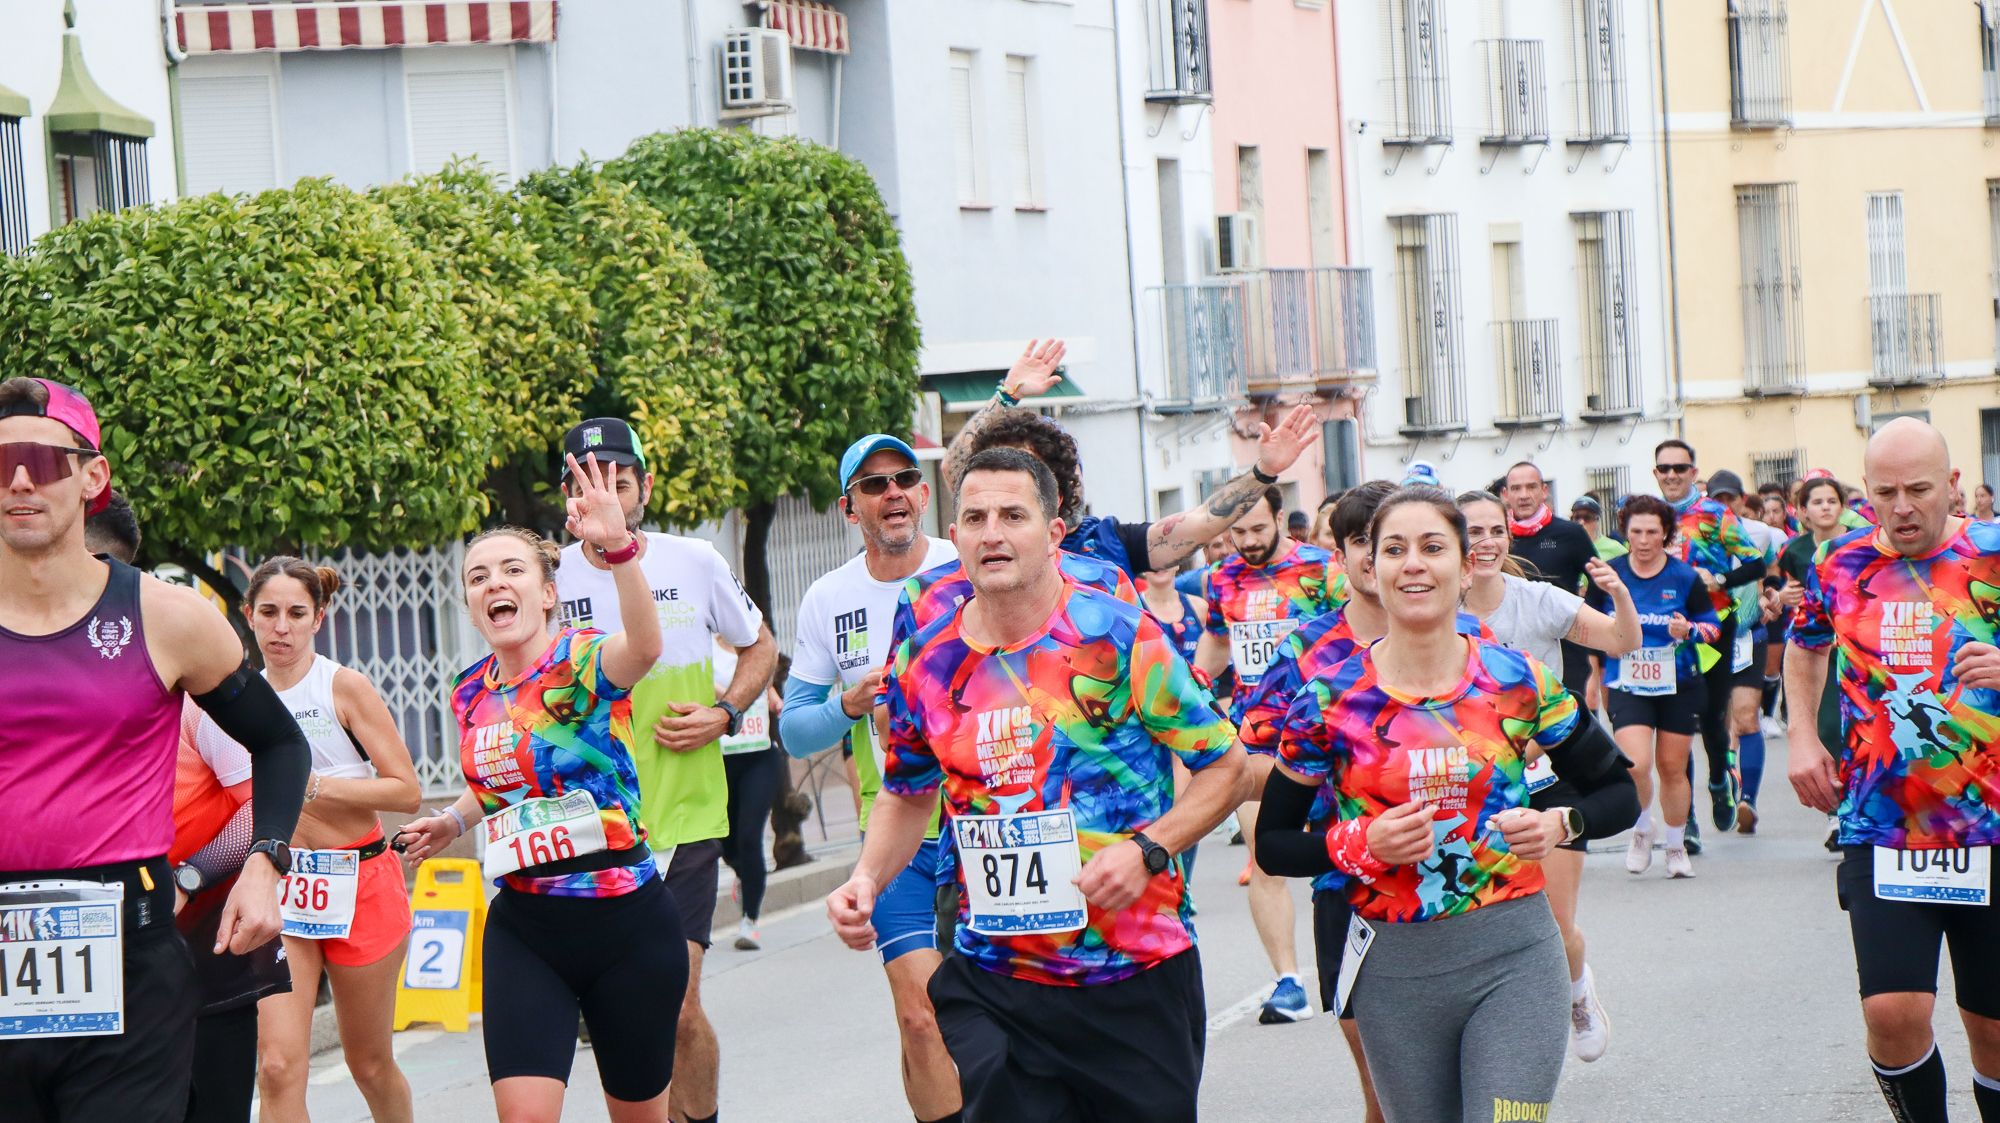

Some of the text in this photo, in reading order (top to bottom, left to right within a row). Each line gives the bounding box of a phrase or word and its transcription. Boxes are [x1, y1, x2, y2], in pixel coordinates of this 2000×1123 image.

[650, 589, 679, 602] IKE
[834, 607, 868, 634] mo
[1881, 601, 1934, 627] XII 08
[1880, 626, 1915, 639] MEDIA
[1880, 637, 1933, 653] MARATÓN
[1631, 662, 1662, 681] 208
[1887, 653, 1910, 666] 10K
[295, 709, 319, 720] BIKE
[975, 705, 1032, 744] XII 08
[474, 720, 514, 753] XII 08
[473, 748, 501, 766] MEDIA
[976, 739, 1017, 761] MEDIA
[1407, 745, 1469, 778] XII 08
[475, 756, 520, 779] MARATÓN
[1407, 775, 1449, 790] MEDIA
[1409, 784, 1469, 802] MARATÓN
[494, 807, 524, 838] 10K
[968, 819, 1004, 848] 21K
[508, 825, 577, 870] 166
[1897, 847, 1971, 874] 1040
[982, 851, 1049, 898] 874
[279, 874, 330, 911] 736
[414, 914, 436, 928] km
[419, 940, 445, 973] 2
[0, 944, 93, 996] 1411
